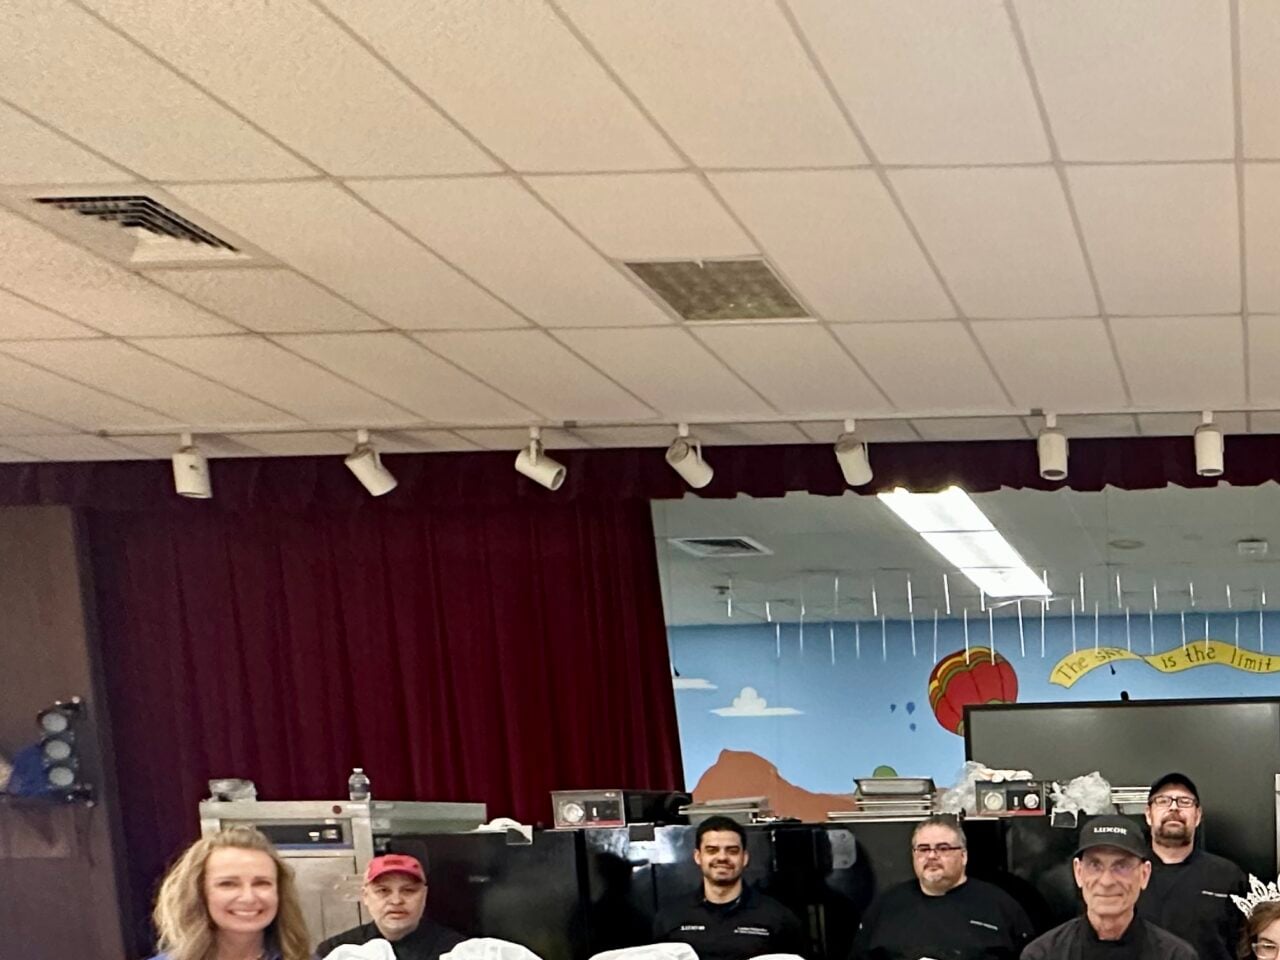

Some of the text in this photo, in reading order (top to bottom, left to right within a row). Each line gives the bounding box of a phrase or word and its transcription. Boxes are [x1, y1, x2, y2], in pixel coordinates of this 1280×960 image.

[1056, 656, 1089, 681] The
[1162, 656, 1177, 669] is
[1185, 646, 1217, 663] the
[1230, 647, 1272, 672] limit
[1093, 826, 1128, 836] LUXOR
